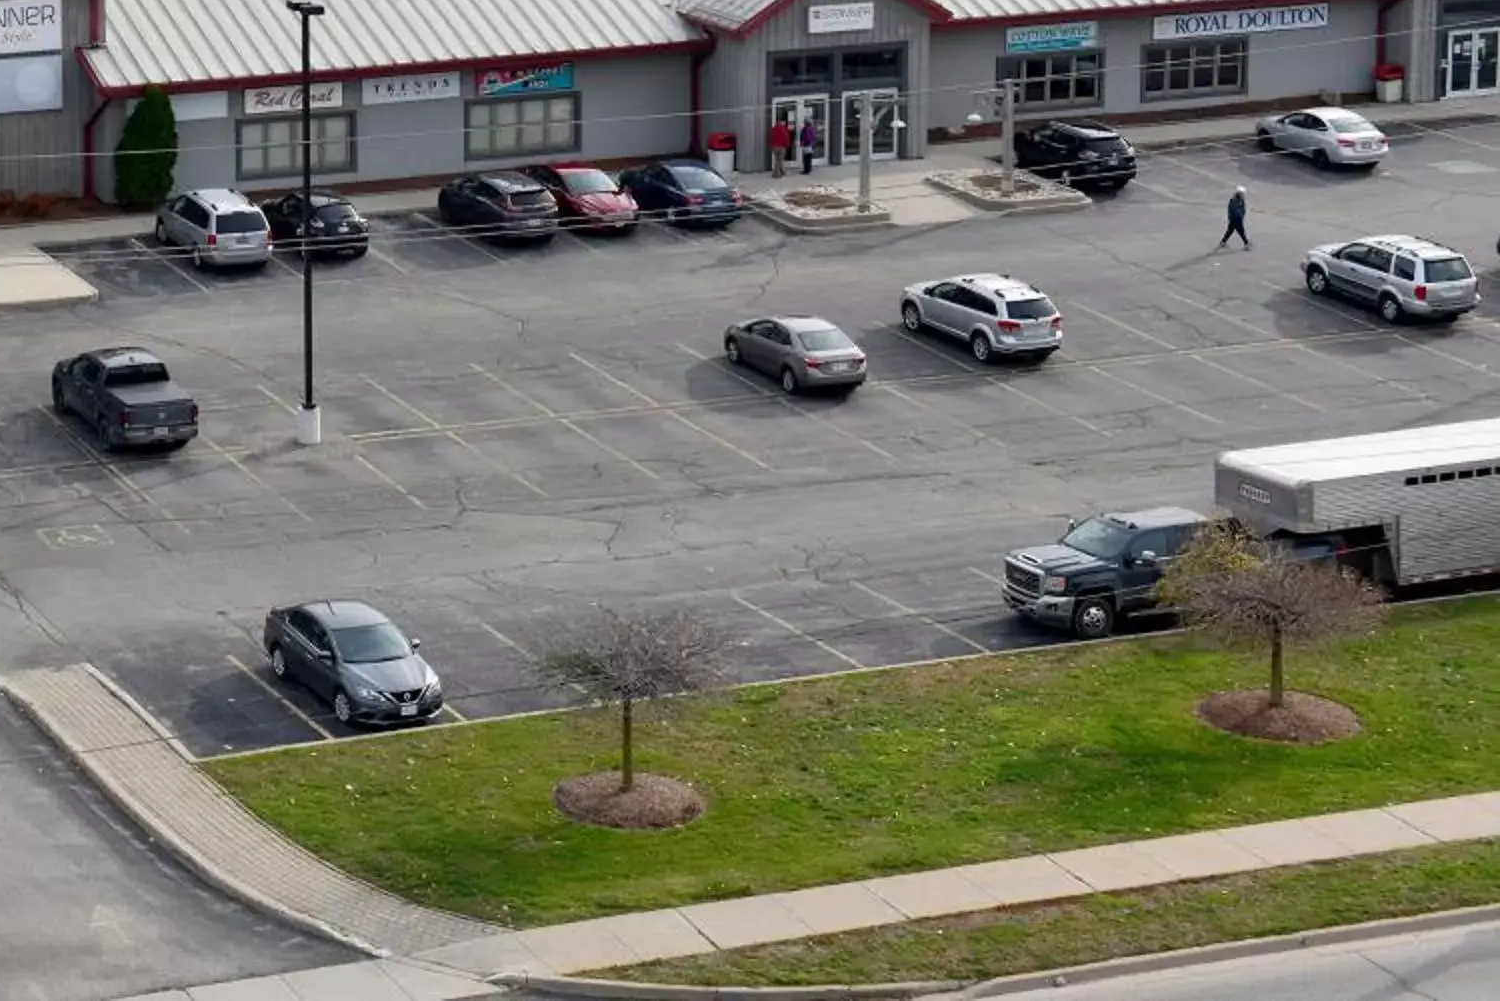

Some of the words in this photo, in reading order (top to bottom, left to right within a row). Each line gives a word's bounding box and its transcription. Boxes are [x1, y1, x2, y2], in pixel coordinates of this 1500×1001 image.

[1175, 16, 1228, 34] ROYAL
[1239, 7, 1326, 28] DOULTON
[254, 90, 287, 107] Red
[289, 86, 335, 108] Cral
